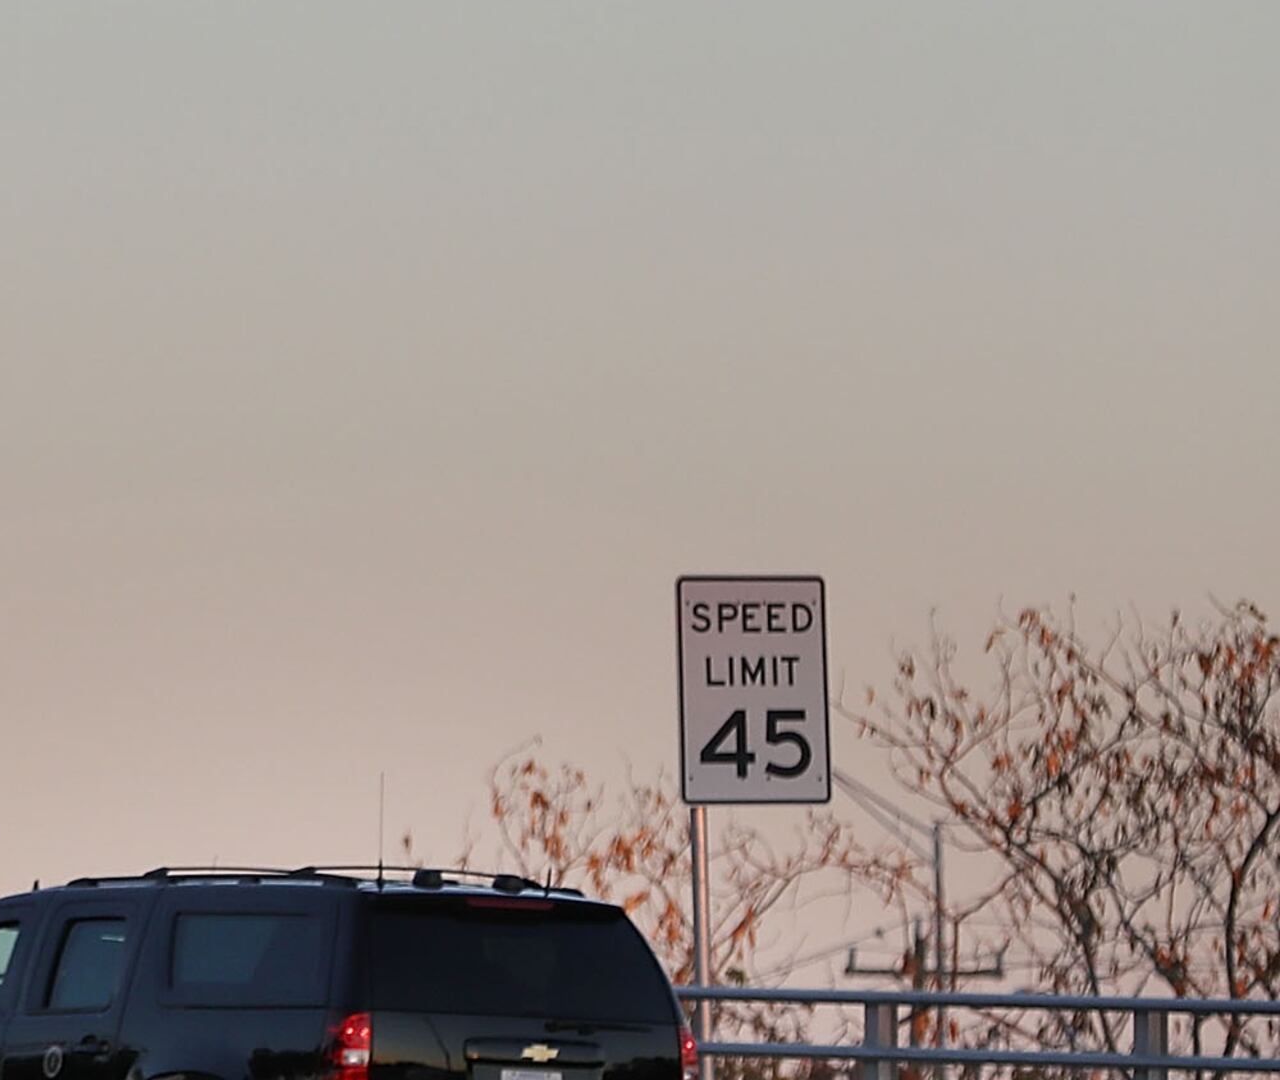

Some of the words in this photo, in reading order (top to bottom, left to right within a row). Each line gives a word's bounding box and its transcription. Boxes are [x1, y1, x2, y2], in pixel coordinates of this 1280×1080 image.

[692, 603, 813, 633] SPEED
[706, 655, 800, 687] LIMIT
[700, 709, 812, 780] 45
